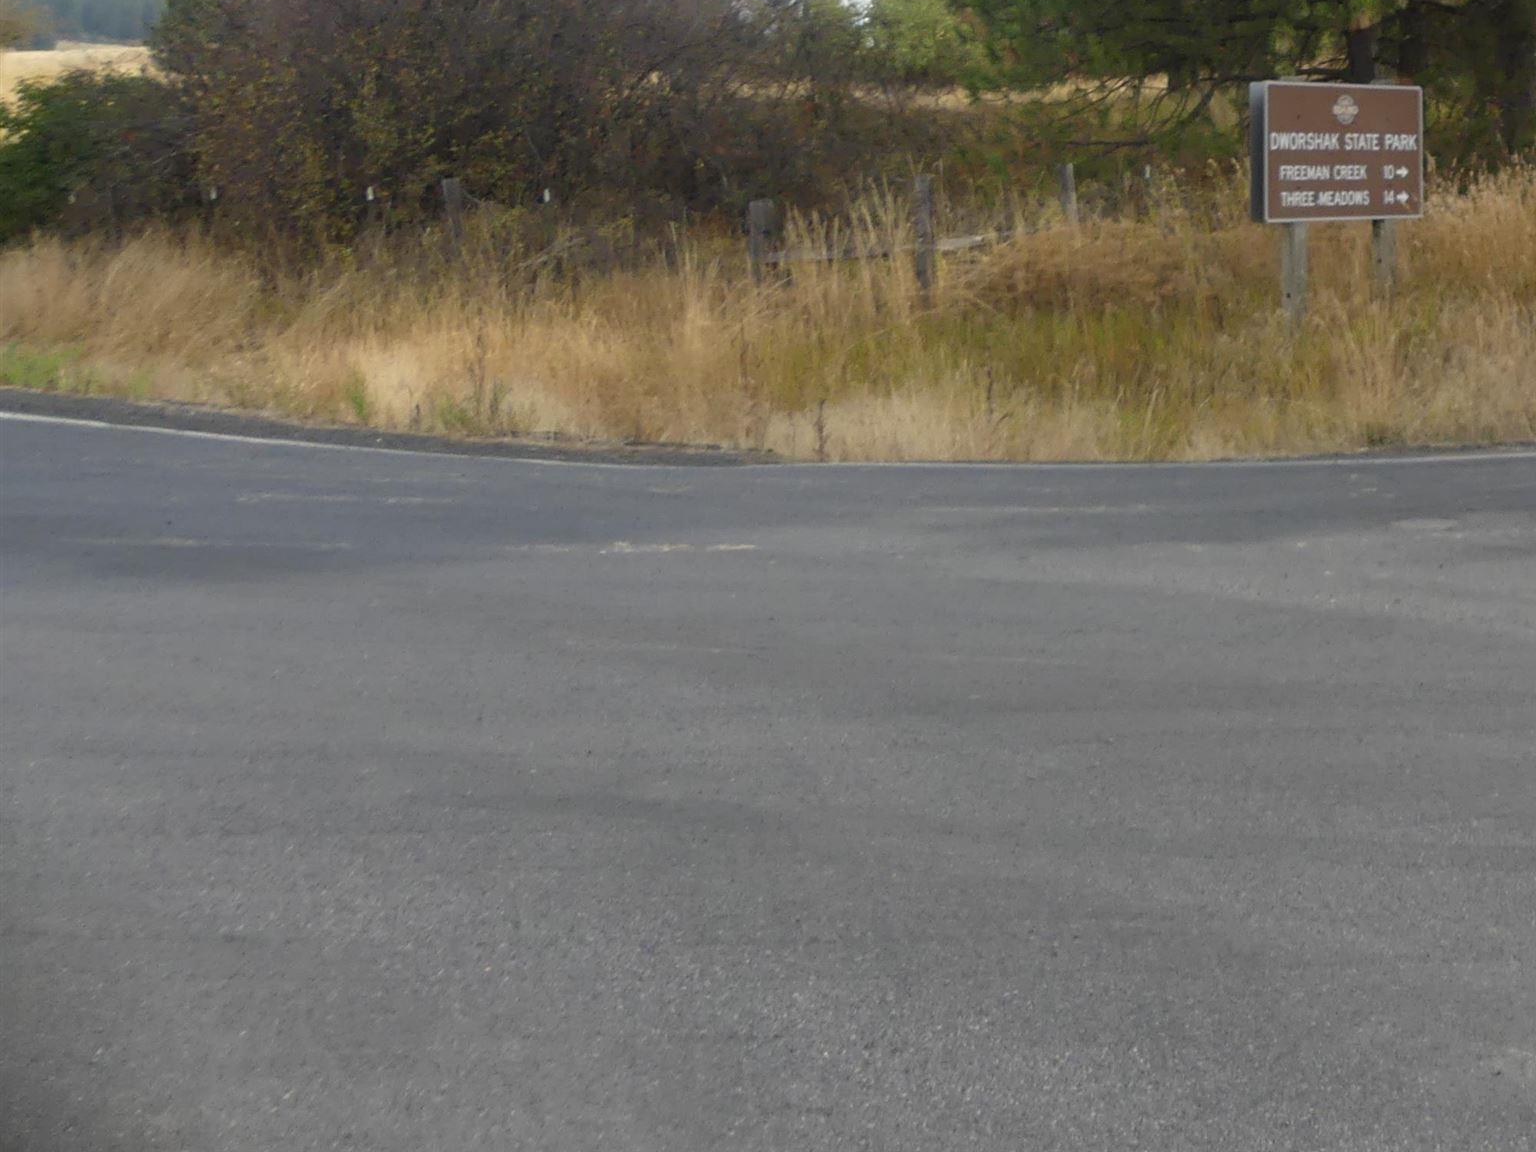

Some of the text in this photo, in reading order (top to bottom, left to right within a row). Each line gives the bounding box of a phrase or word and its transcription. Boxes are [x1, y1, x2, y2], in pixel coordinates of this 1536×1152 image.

[1270, 132, 1417, 150] DWORSHAK STATE PARK
[1279, 165, 1395, 181] FREEMAN CREEK 10
[1280, 190, 1395, 207] THREE MEADOWS 14
